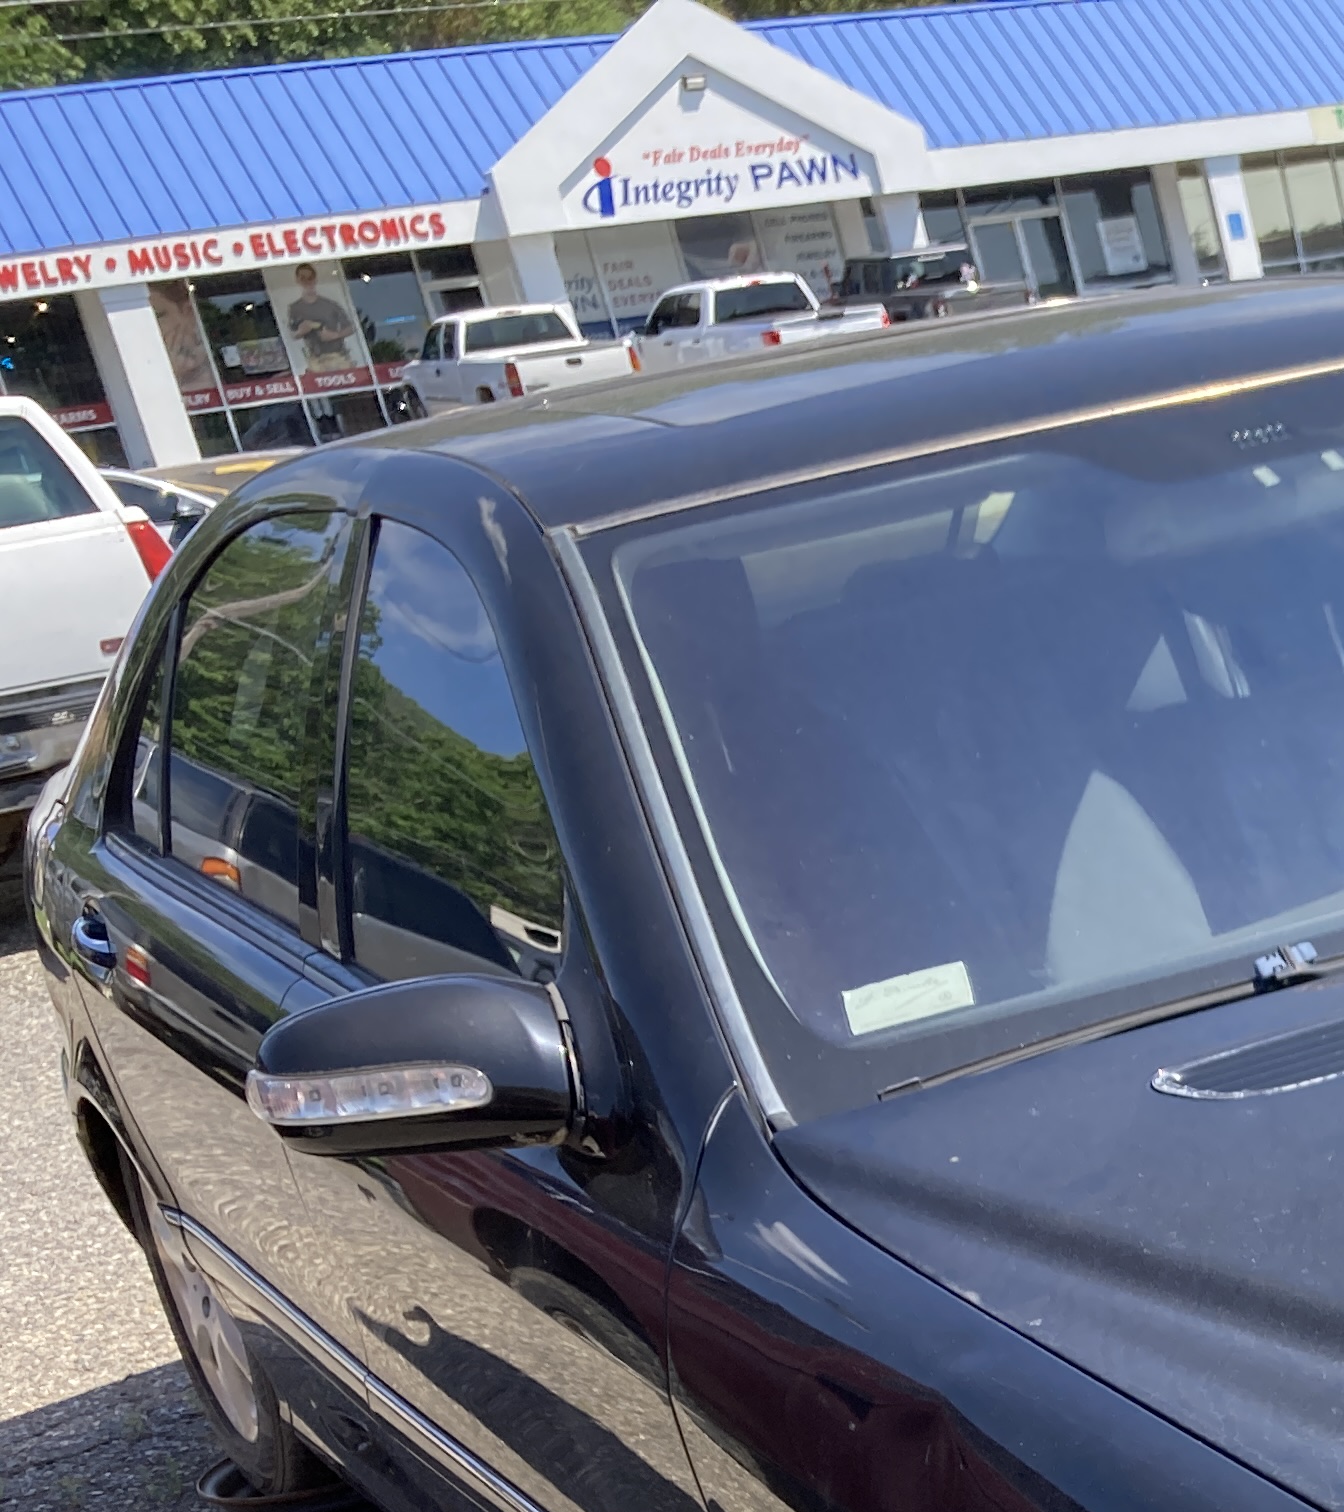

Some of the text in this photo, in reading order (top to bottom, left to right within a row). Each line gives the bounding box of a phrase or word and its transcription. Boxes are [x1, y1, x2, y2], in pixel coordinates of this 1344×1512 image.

[689, 143, 731, 163] Deals
[618, 152, 860, 209] Integrity PAWN
[126, 237, 223, 277] MUSIC
[248, 211, 446, 261] ELECTRONICS
[314, 372, 355, 388] TOOLS
[225, 386, 251, 401] BUY
[266, 381, 295, 395] SELL
